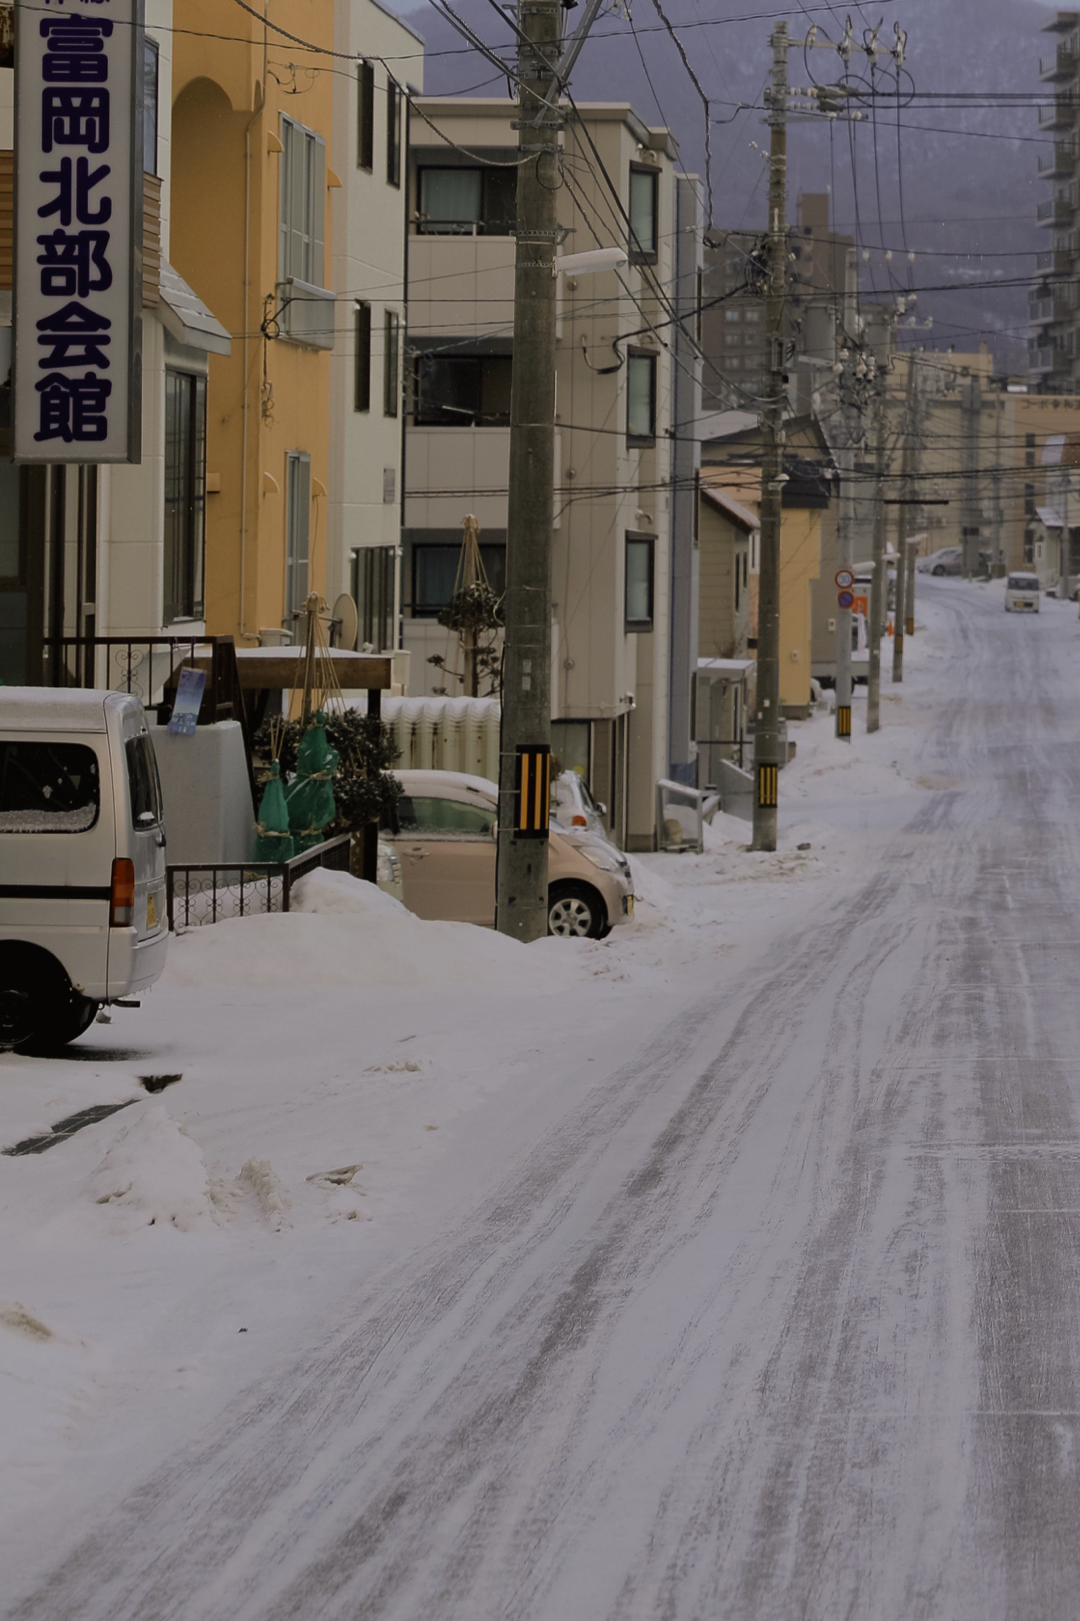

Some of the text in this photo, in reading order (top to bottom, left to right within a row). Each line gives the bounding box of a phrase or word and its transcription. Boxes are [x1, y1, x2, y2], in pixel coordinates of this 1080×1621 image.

[33, 14, 113, 443] 富岡北部会館
